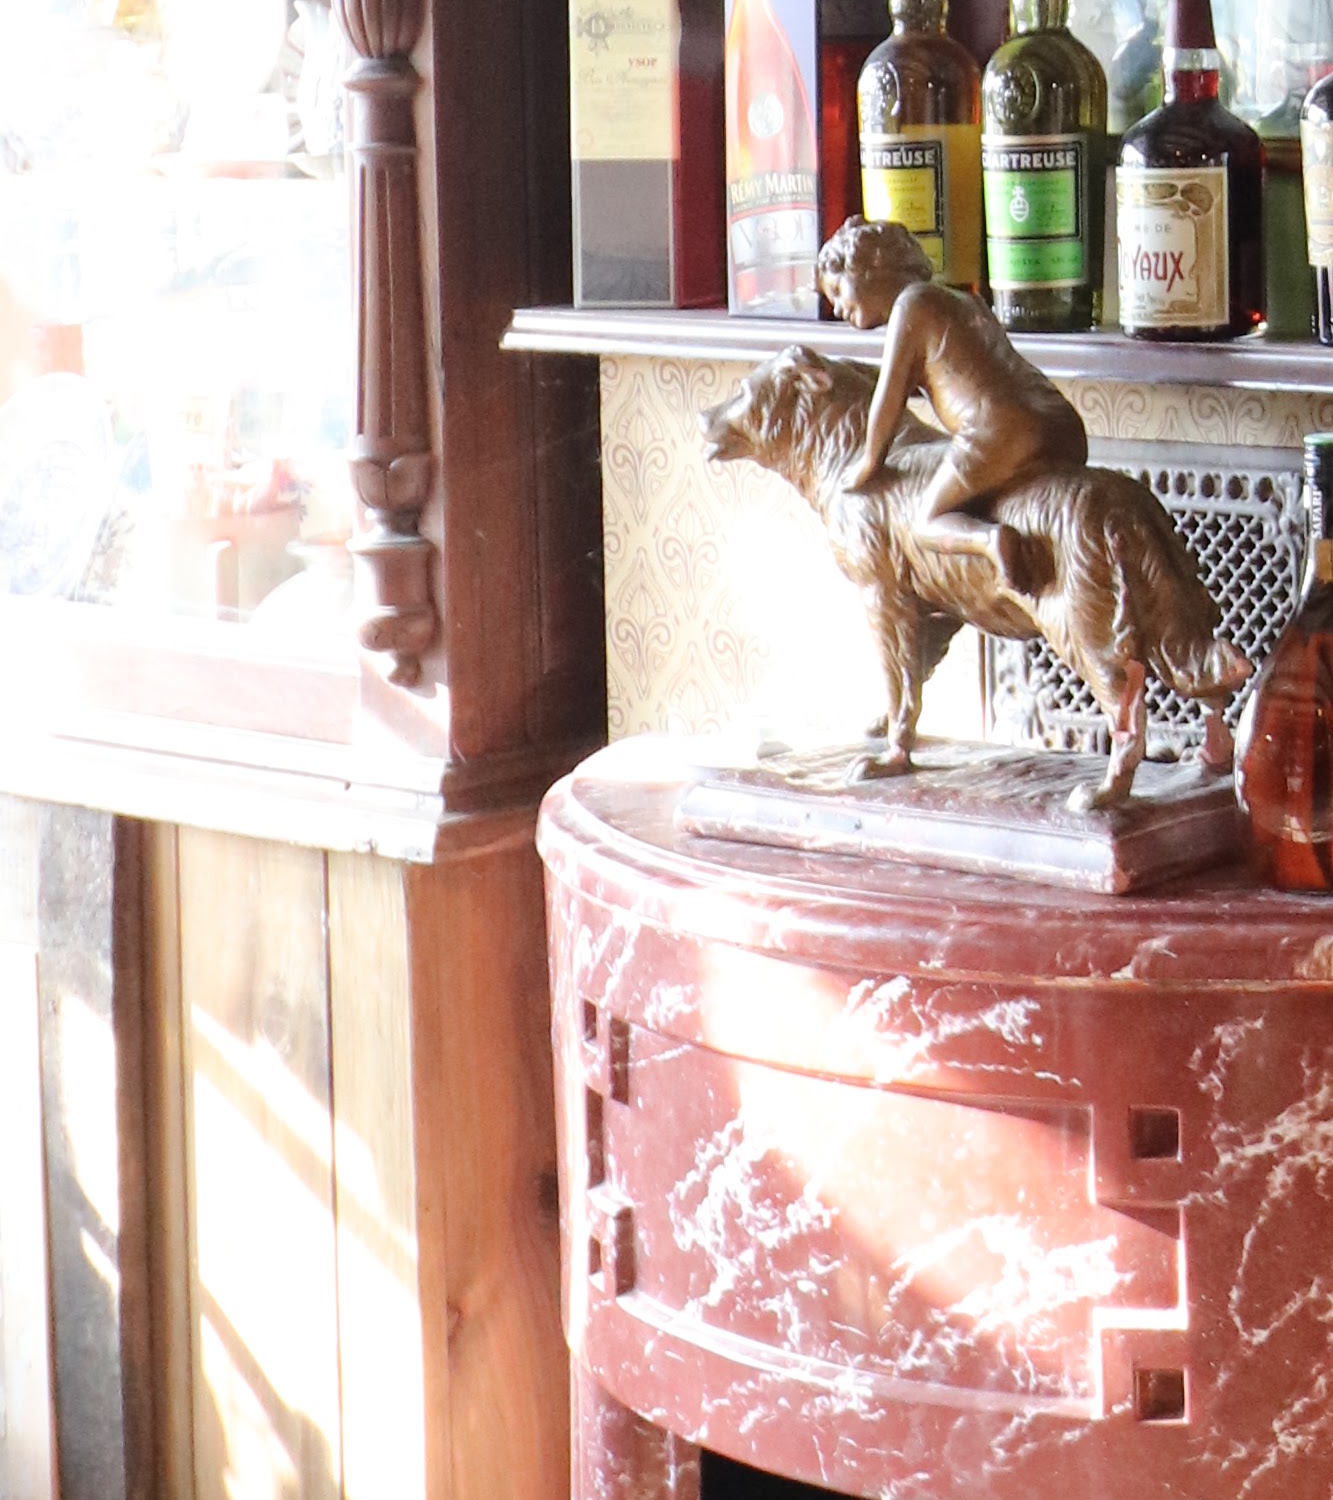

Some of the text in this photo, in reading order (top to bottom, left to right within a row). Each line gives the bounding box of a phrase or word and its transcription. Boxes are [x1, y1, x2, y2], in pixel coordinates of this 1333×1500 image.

[627, 56, 658, 69] VSOP
[729, 176, 762, 205] RÉMY
[764, 171, 814, 197] MARTIN
[1154, 223, 1172, 233] DE
